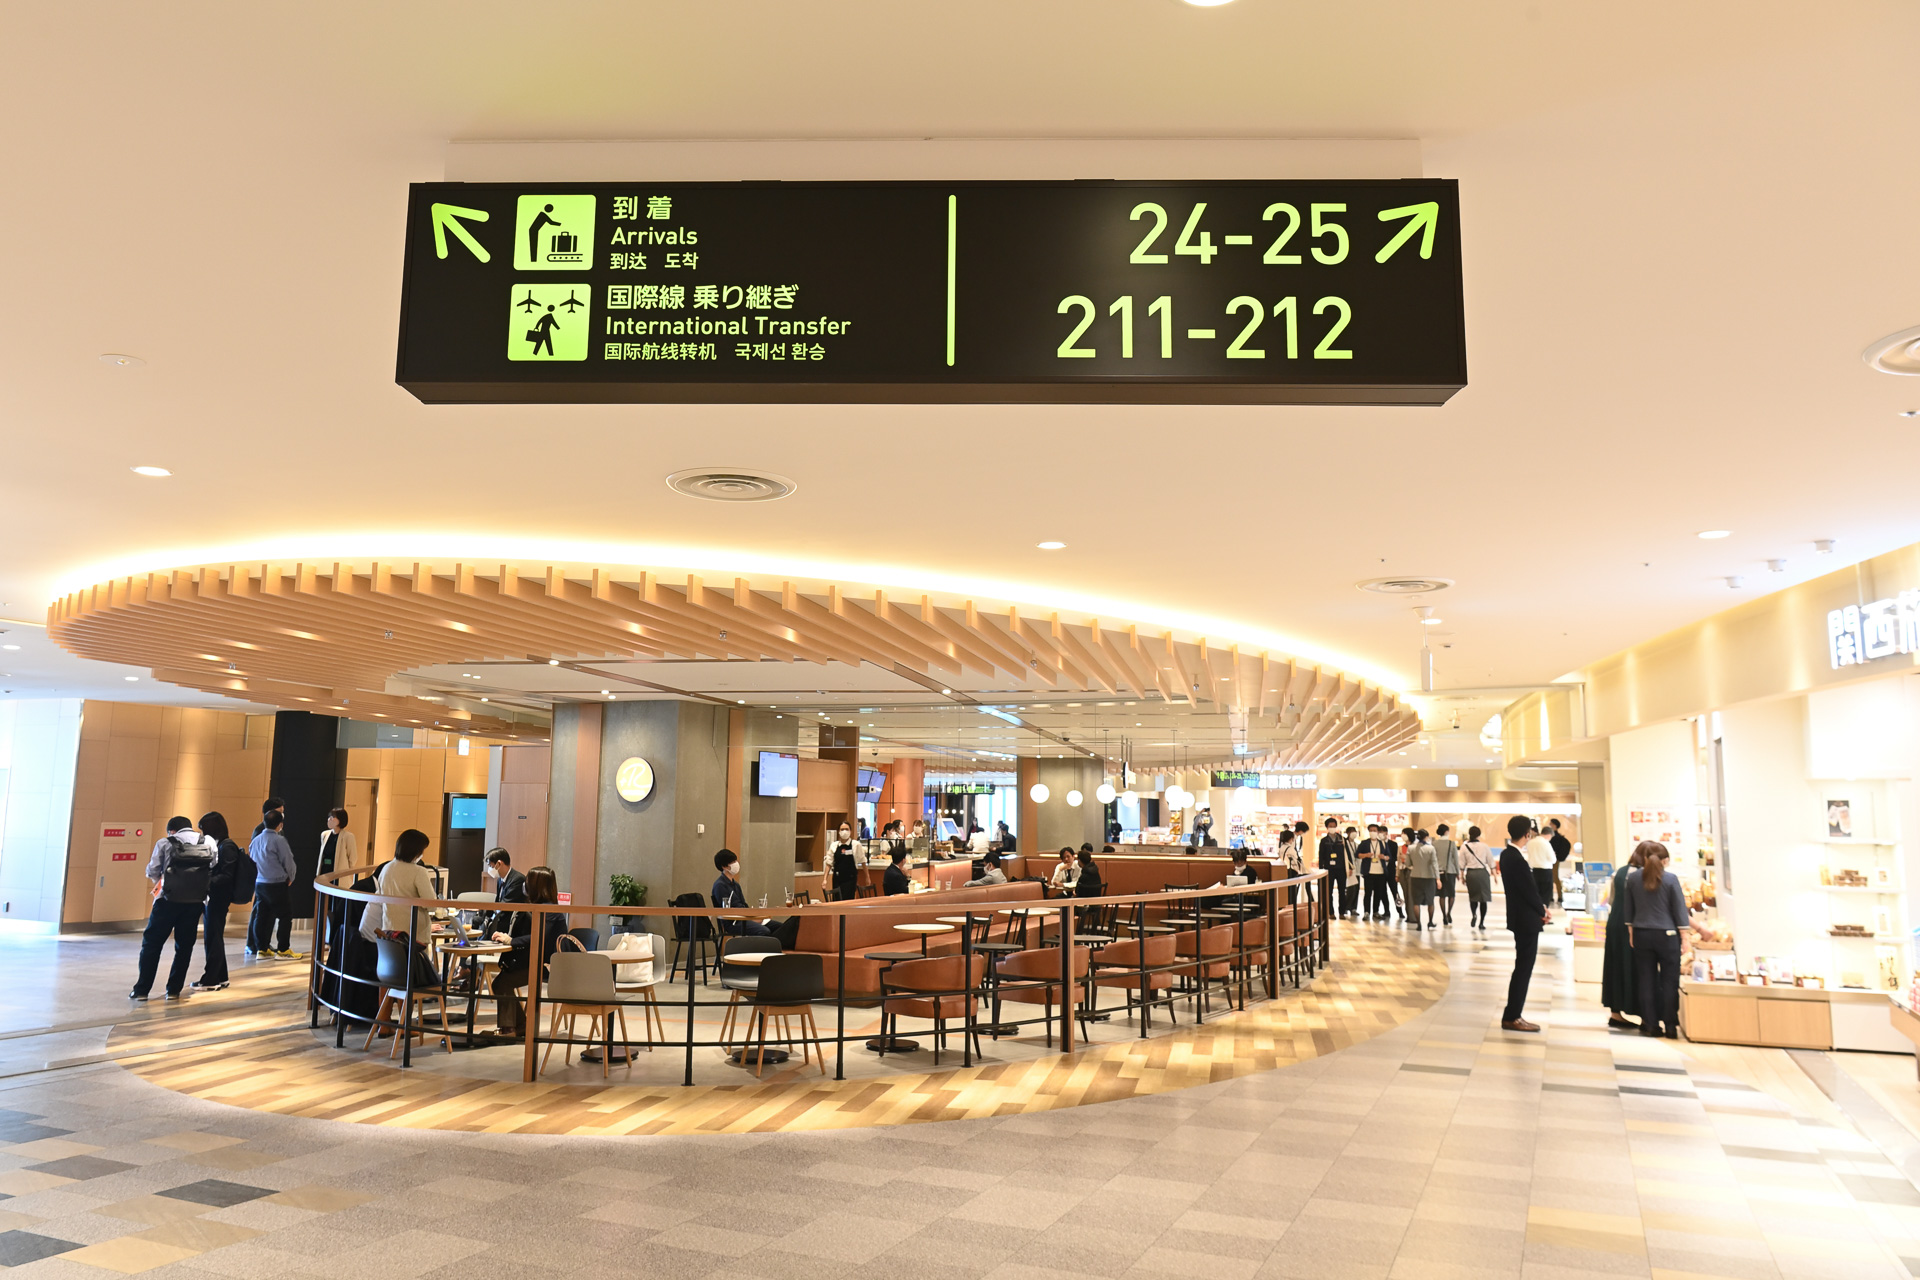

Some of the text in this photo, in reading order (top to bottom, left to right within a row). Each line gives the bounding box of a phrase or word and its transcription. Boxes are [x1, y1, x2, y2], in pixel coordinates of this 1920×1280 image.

[611, 227, 697, 245] Arrivals
[1130, 202, 1349, 265] 24-25
[610, 251, 647, 270] 到达
[664, 252, 699, 270] 도착
[607, 284, 799, 309] 国際線 乗り継ぎ
[606, 316, 851, 335] International Transfer
[1057, 295, 1352, 359] 211-212
[604, 342, 717, 361] 国际航线转机
[735, 342, 826, 361] 국제선 환승
